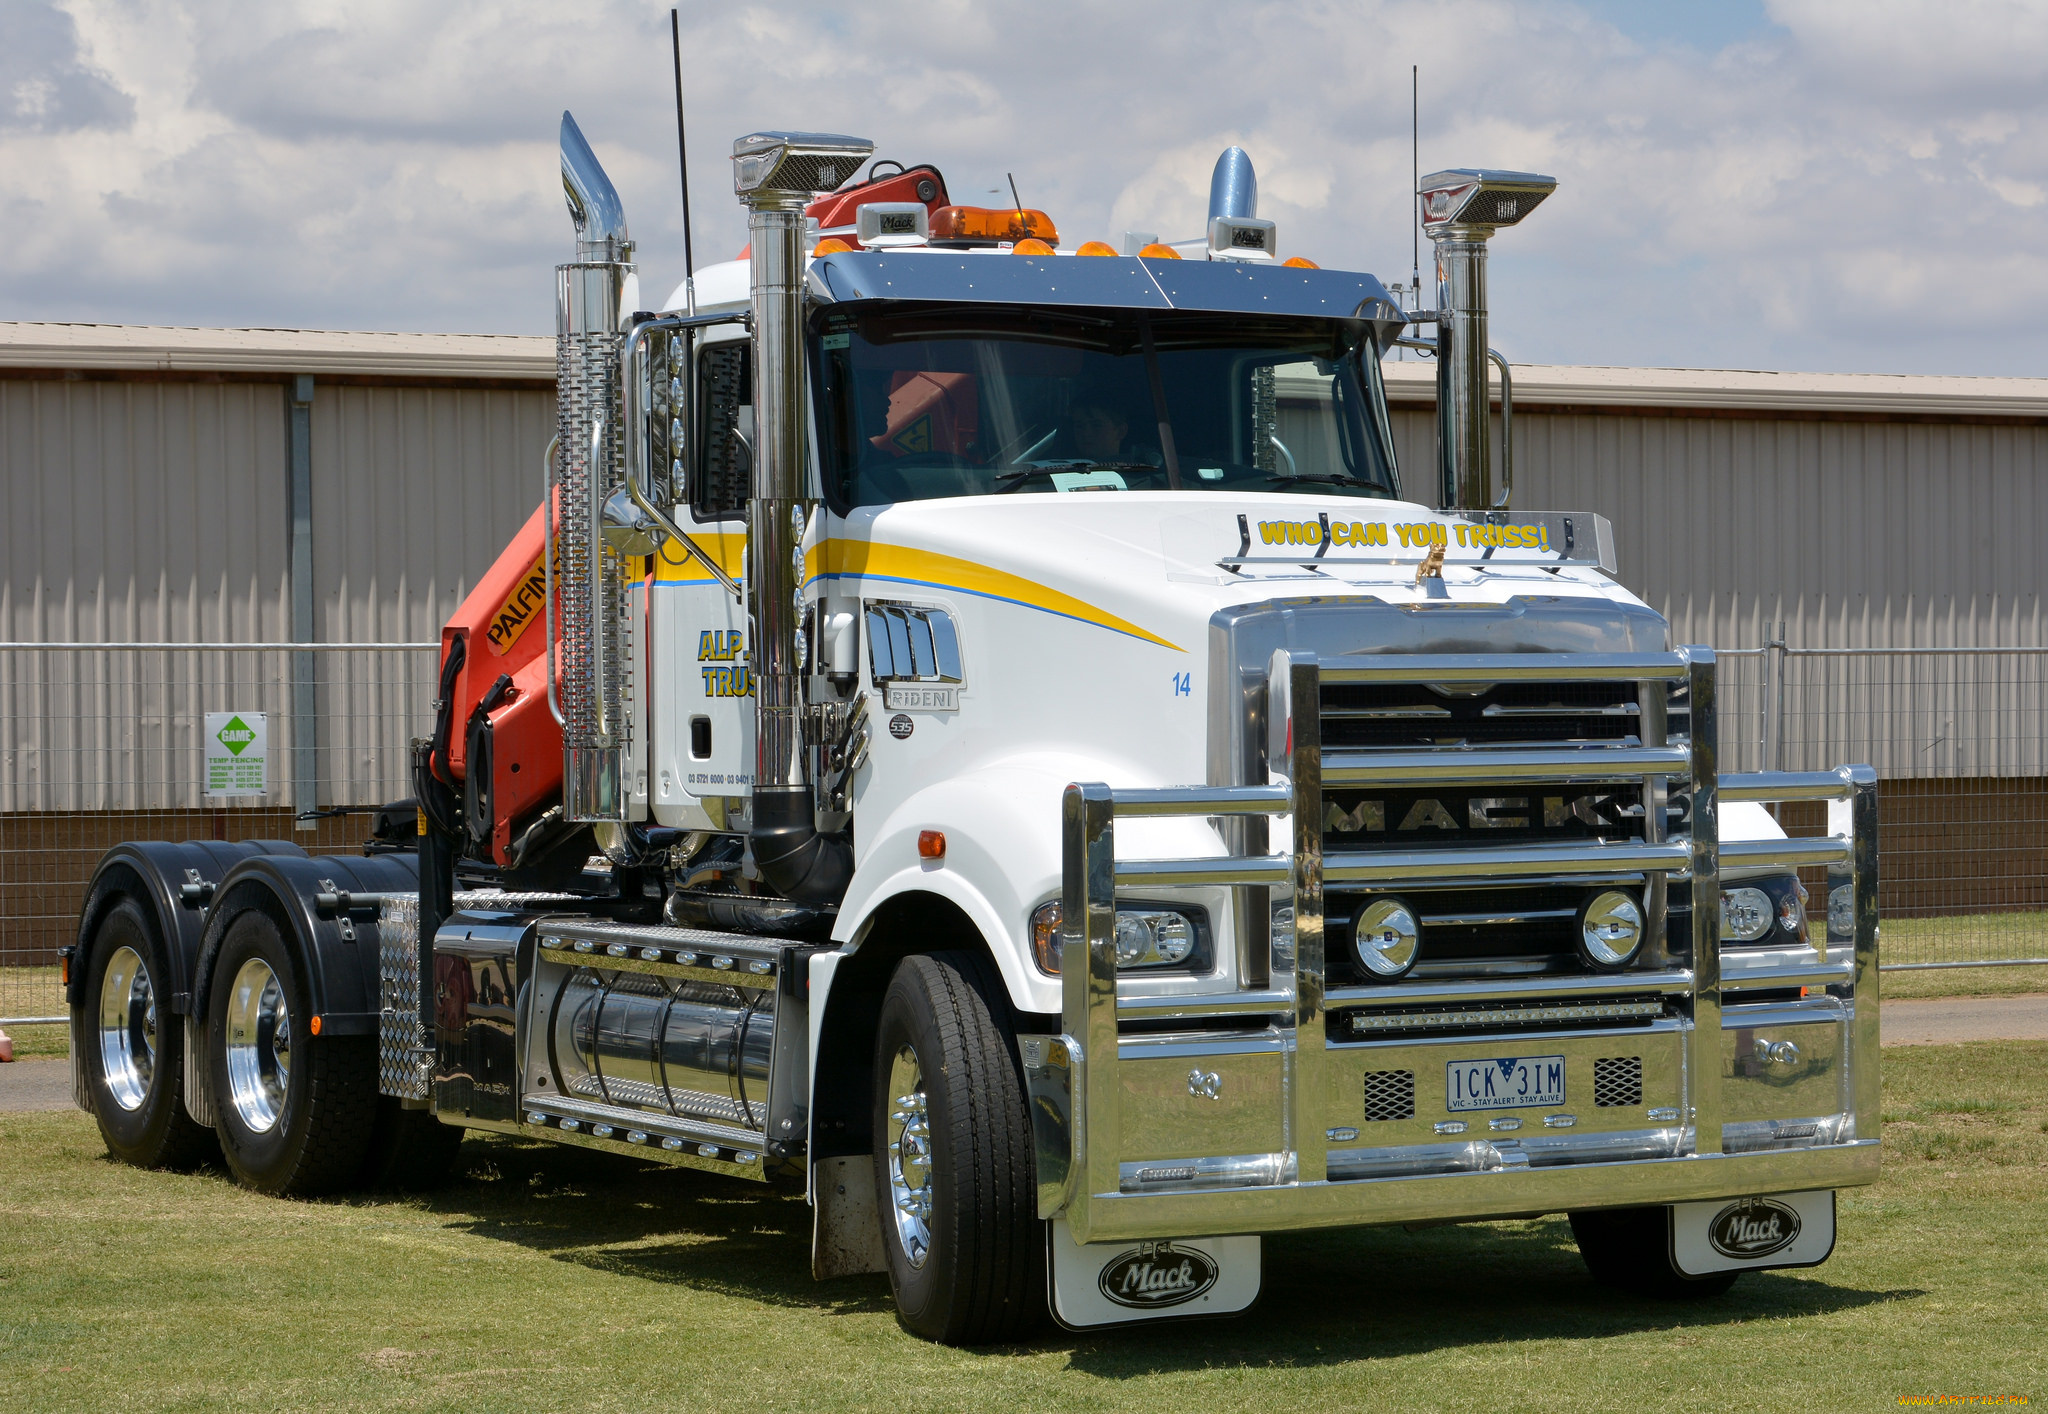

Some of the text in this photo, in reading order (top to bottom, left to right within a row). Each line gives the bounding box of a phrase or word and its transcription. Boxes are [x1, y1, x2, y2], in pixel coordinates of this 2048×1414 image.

[882, 215, 914, 231] Mack
[1257, 520, 1550, 553] WHO CAN YOU TRUSS!
[486, 541, 561, 646] PALFIN
[1172, 671, 1191, 697] 14
[221, 729, 251, 742] GAME
[890, 721, 912, 733] 535
[688, 773, 695, 783] 03
[726, 774, 734, 784] 03
[1322, 795, 1614, 833] MACK
[1454, 1067, 1496, 1099] 1CK
[1452, 1100, 1465, 1108] VIC
[1473, 1098, 1492, 1107] STAY
[1493, 1096, 1516, 1105] ALERT
[1519, 1096, 1537, 1104] STAY
[1539, 1094, 1560, 1102] ALIVE
[1723, 1212, 1784, 1250] Mack
[1120, 1258, 1197, 1299] Mack
